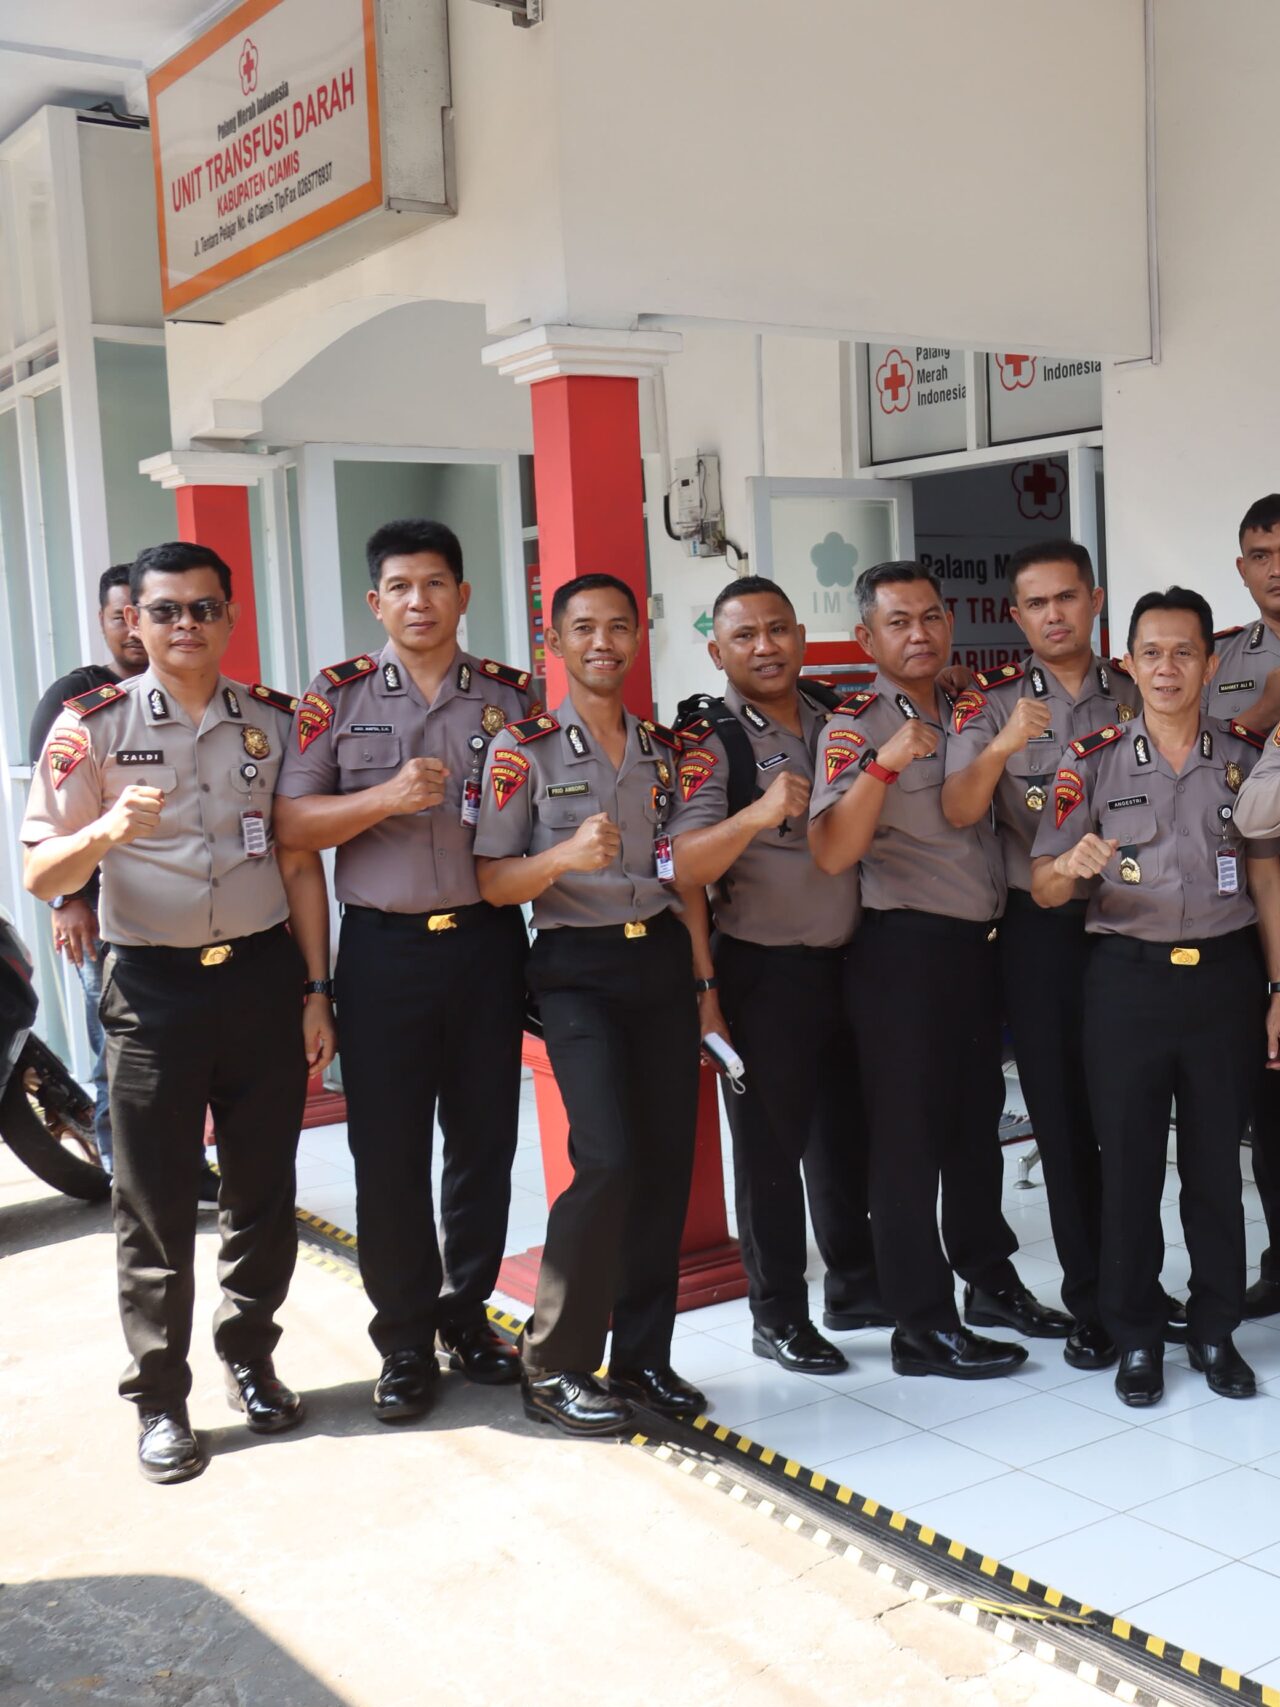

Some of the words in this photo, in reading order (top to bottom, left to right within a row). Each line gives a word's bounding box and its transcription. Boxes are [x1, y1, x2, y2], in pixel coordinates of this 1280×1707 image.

[217, 116, 237, 141] Palang
[237, 102, 256, 129] Merah
[256, 80, 289, 116] Indonesia
[172, 165, 202, 212] UNIT
[205, 109, 289, 192] TRANSFUSI
[292, 67, 354, 139] DARAH
[217, 170, 266, 218] KABUPATEN
[267, 150, 300, 188] CIAMIS
[200, 233, 219, 252] Tentara
[219, 221, 237, 242] Pelajar
[255, 198, 274, 222] Ciamis
[917, 365, 948, 385] Merah
[917, 383, 966, 406] Indonesia
[921, 554, 987, 585] Palang
[122, 753, 159, 761] ZALDI
[1114, 798, 1142, 808] ANGESTRI
